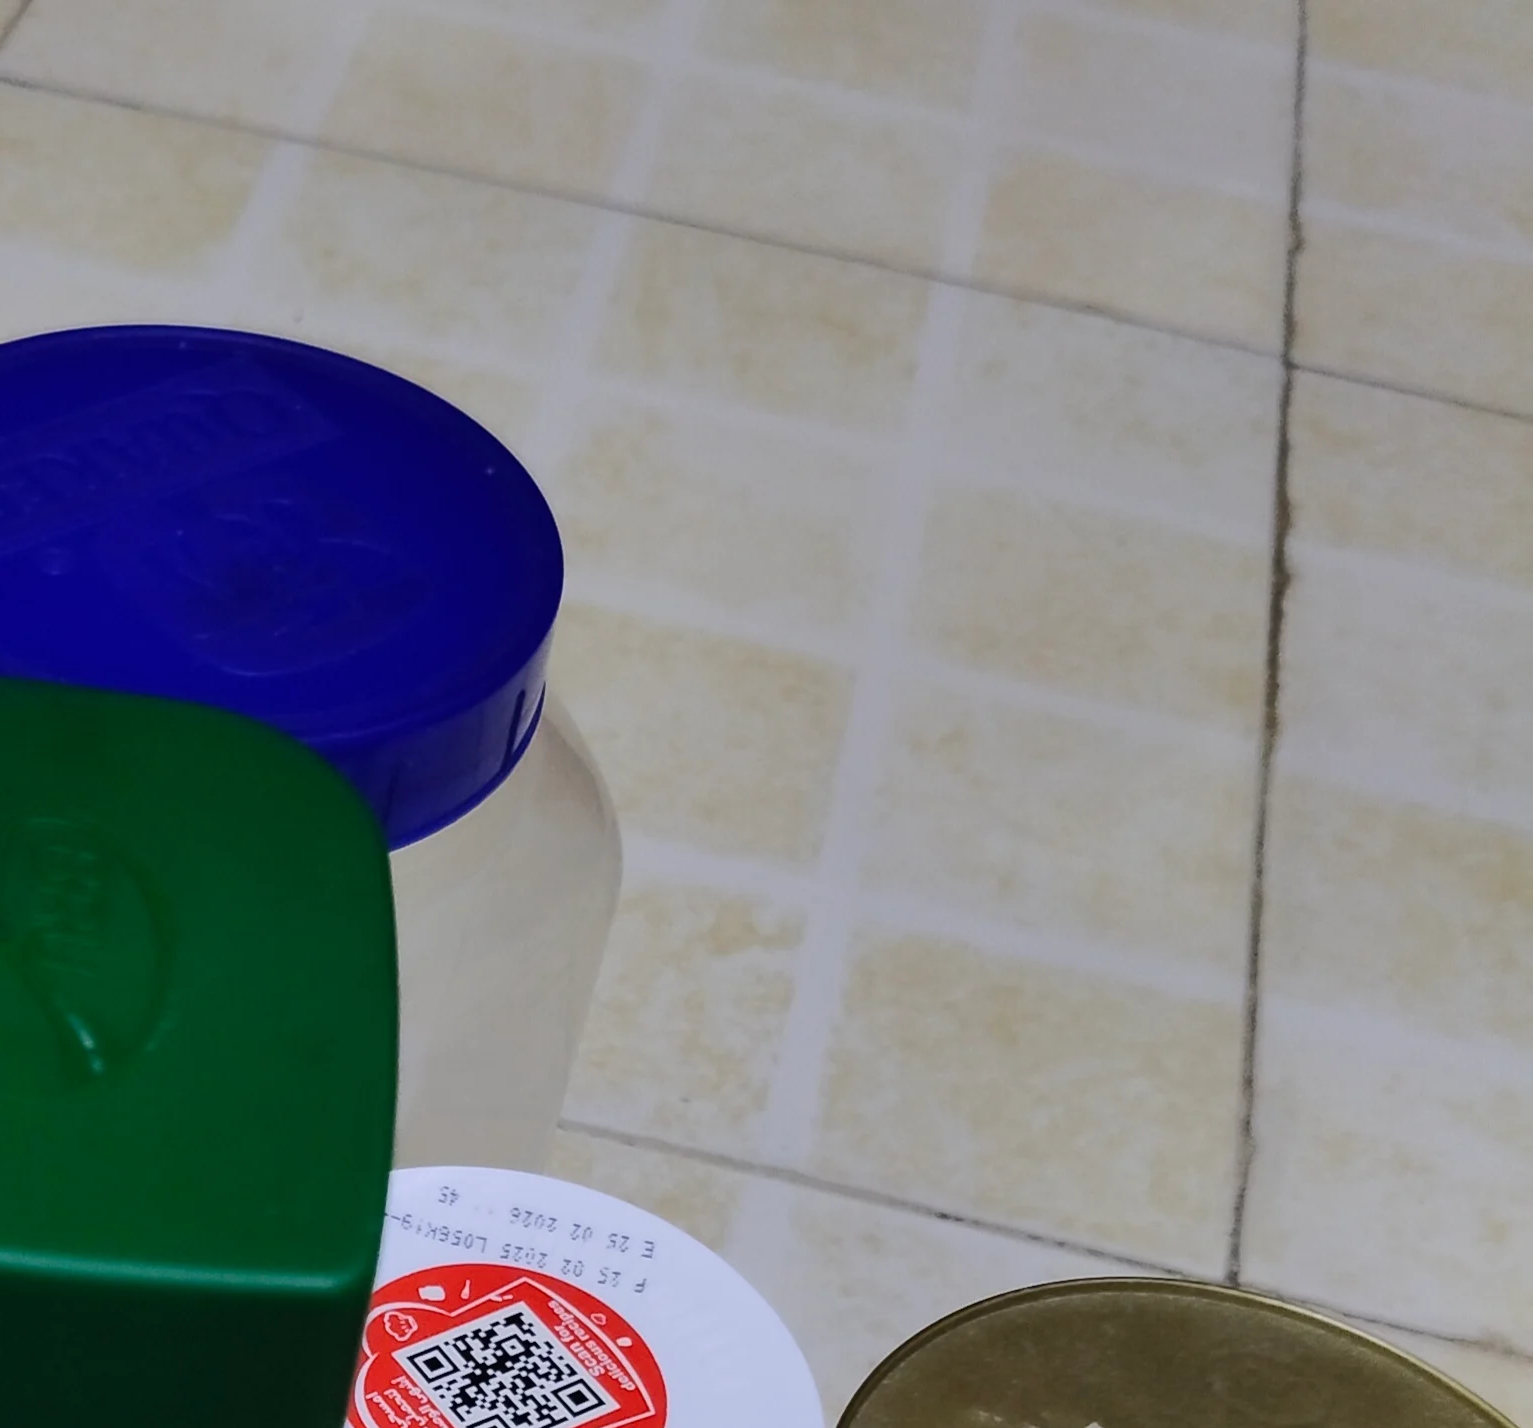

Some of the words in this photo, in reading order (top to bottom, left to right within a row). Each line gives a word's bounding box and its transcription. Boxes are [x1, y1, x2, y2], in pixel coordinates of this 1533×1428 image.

[507, 1205, 560, 1235] 2026
[567, 1221, 594, 1244] 02
[498, 1239, 549, 1271] 2025
[604, 1230, 631, 1254] 25
[558, 1255, 586, 1279] 02
[546, 1299, 590, 1343] recipes
[552, 1322, 575, 1344] for
[568, 1339, 606, 1378] Scan
[585, 1338, 636, 1391] delicious
